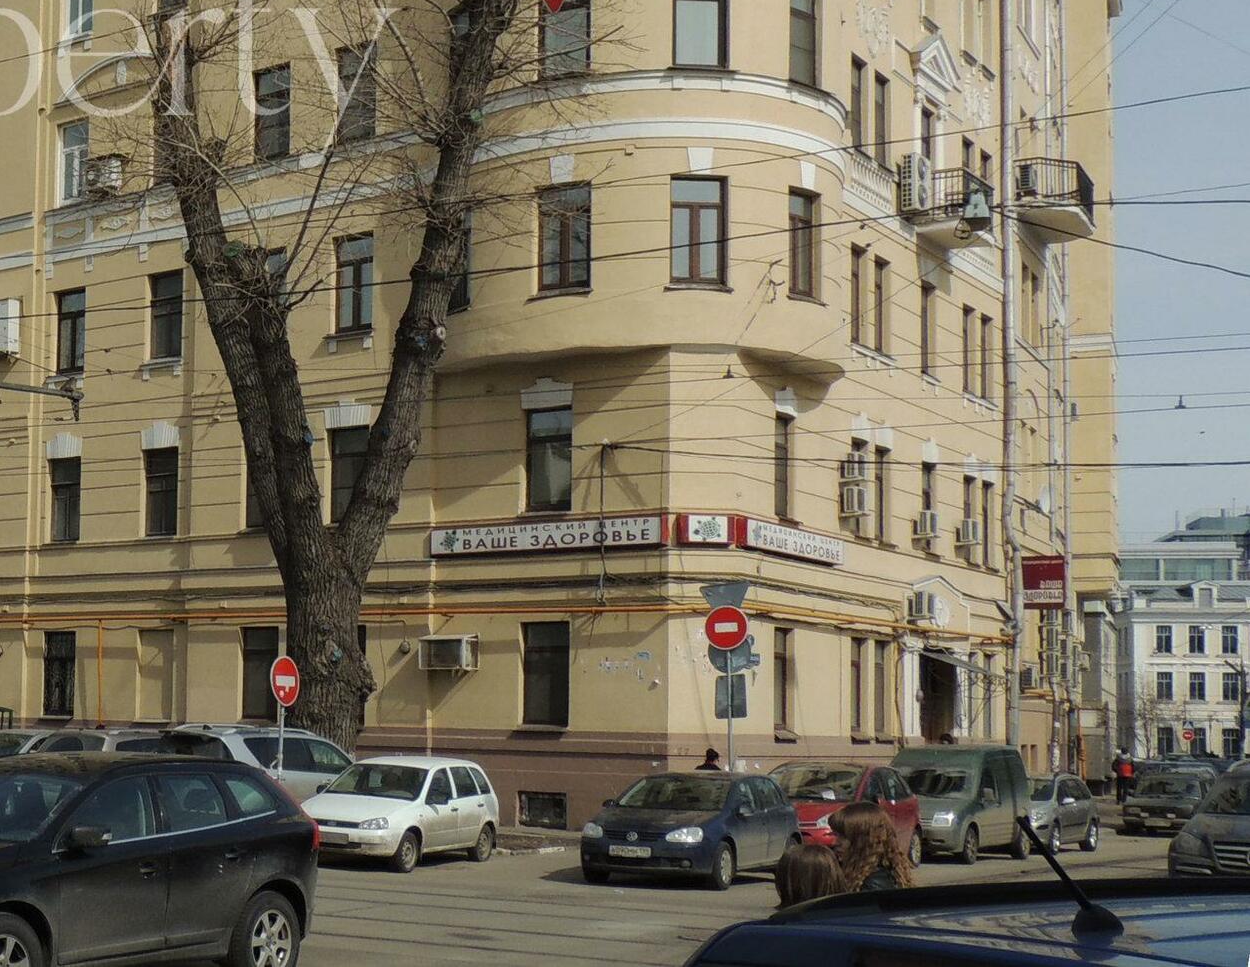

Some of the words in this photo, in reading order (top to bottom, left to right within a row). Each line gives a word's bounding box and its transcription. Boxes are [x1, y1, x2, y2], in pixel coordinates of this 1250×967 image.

[462, 522, 586, 536] МЕДИЦИНСКИЙ
[600, 518, 650, 531] ЦЕНТР
[762, 525, 816, 542] МЕДИЦИНСКИЙ
[820, 537, 841, 547] ЦЕНТР
[462, 534, 519, 550] ВАШЕ
[530, 528, 651, 549] ЗДОРОВЬЕ
[762, 533, 789, 550] ВАШЕ
[792, 541, 841, 561] ЗДОРОВЬЕ
